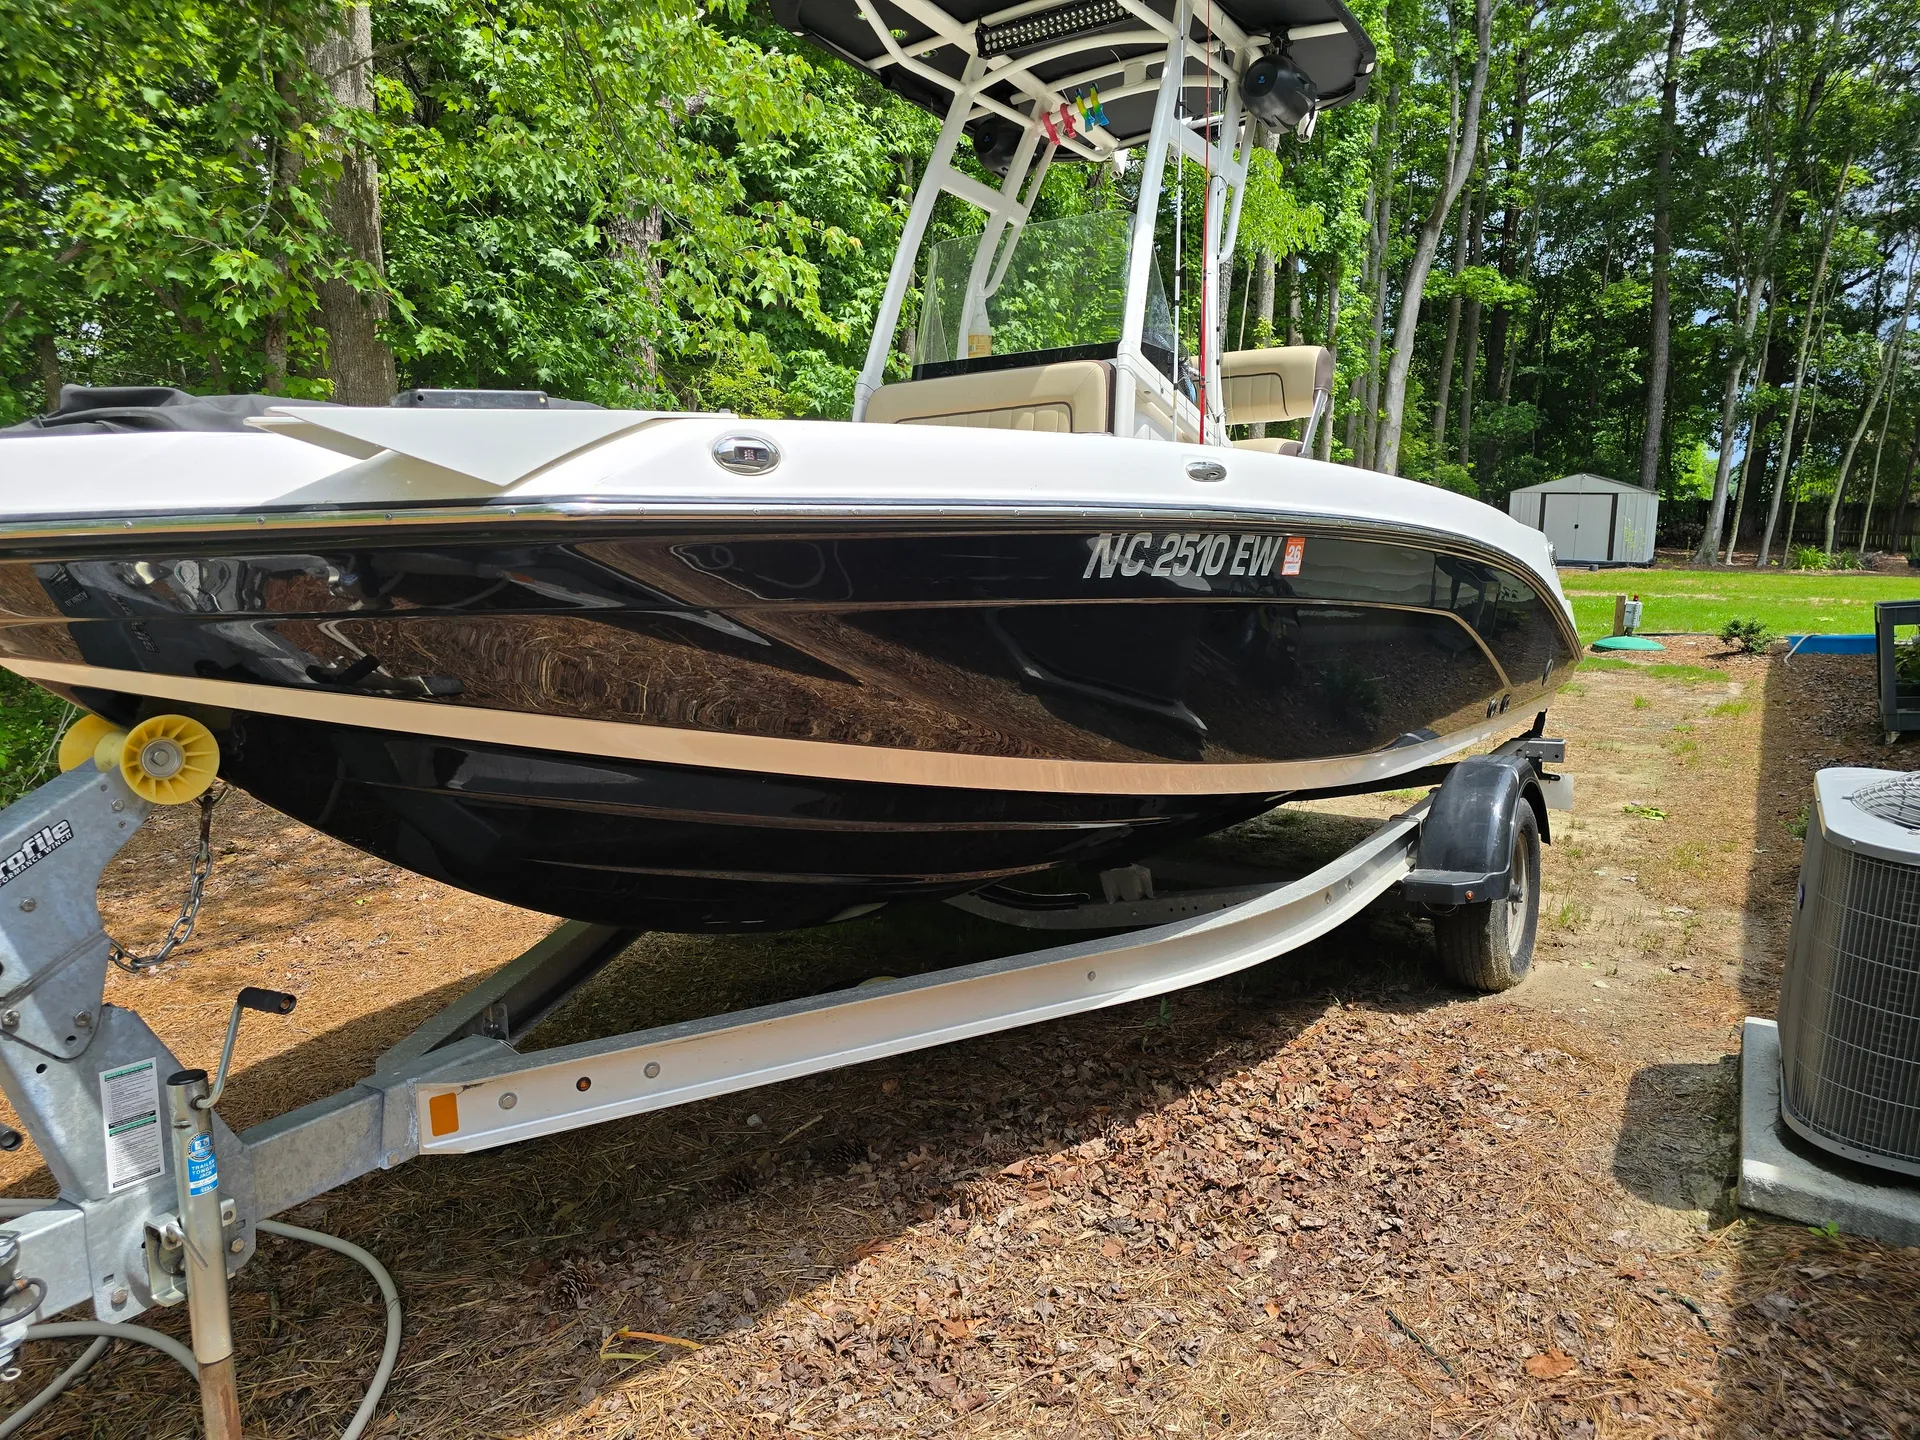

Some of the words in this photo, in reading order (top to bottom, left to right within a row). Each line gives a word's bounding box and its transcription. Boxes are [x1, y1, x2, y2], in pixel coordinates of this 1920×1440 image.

[1083, 532, 1152, 578] NC
[1151, 533, 1231, 577] 2510
[1229, 534, 1283, 576] EW
[1286, 544, 1301, 562] 26
[44, 832, 72, 854] WINCH
[191, 1159, 215, 1171] TRAILER
[191, 1163, 216, 1176] TONGUE
[199, 1171, 212, 1180] JACK
